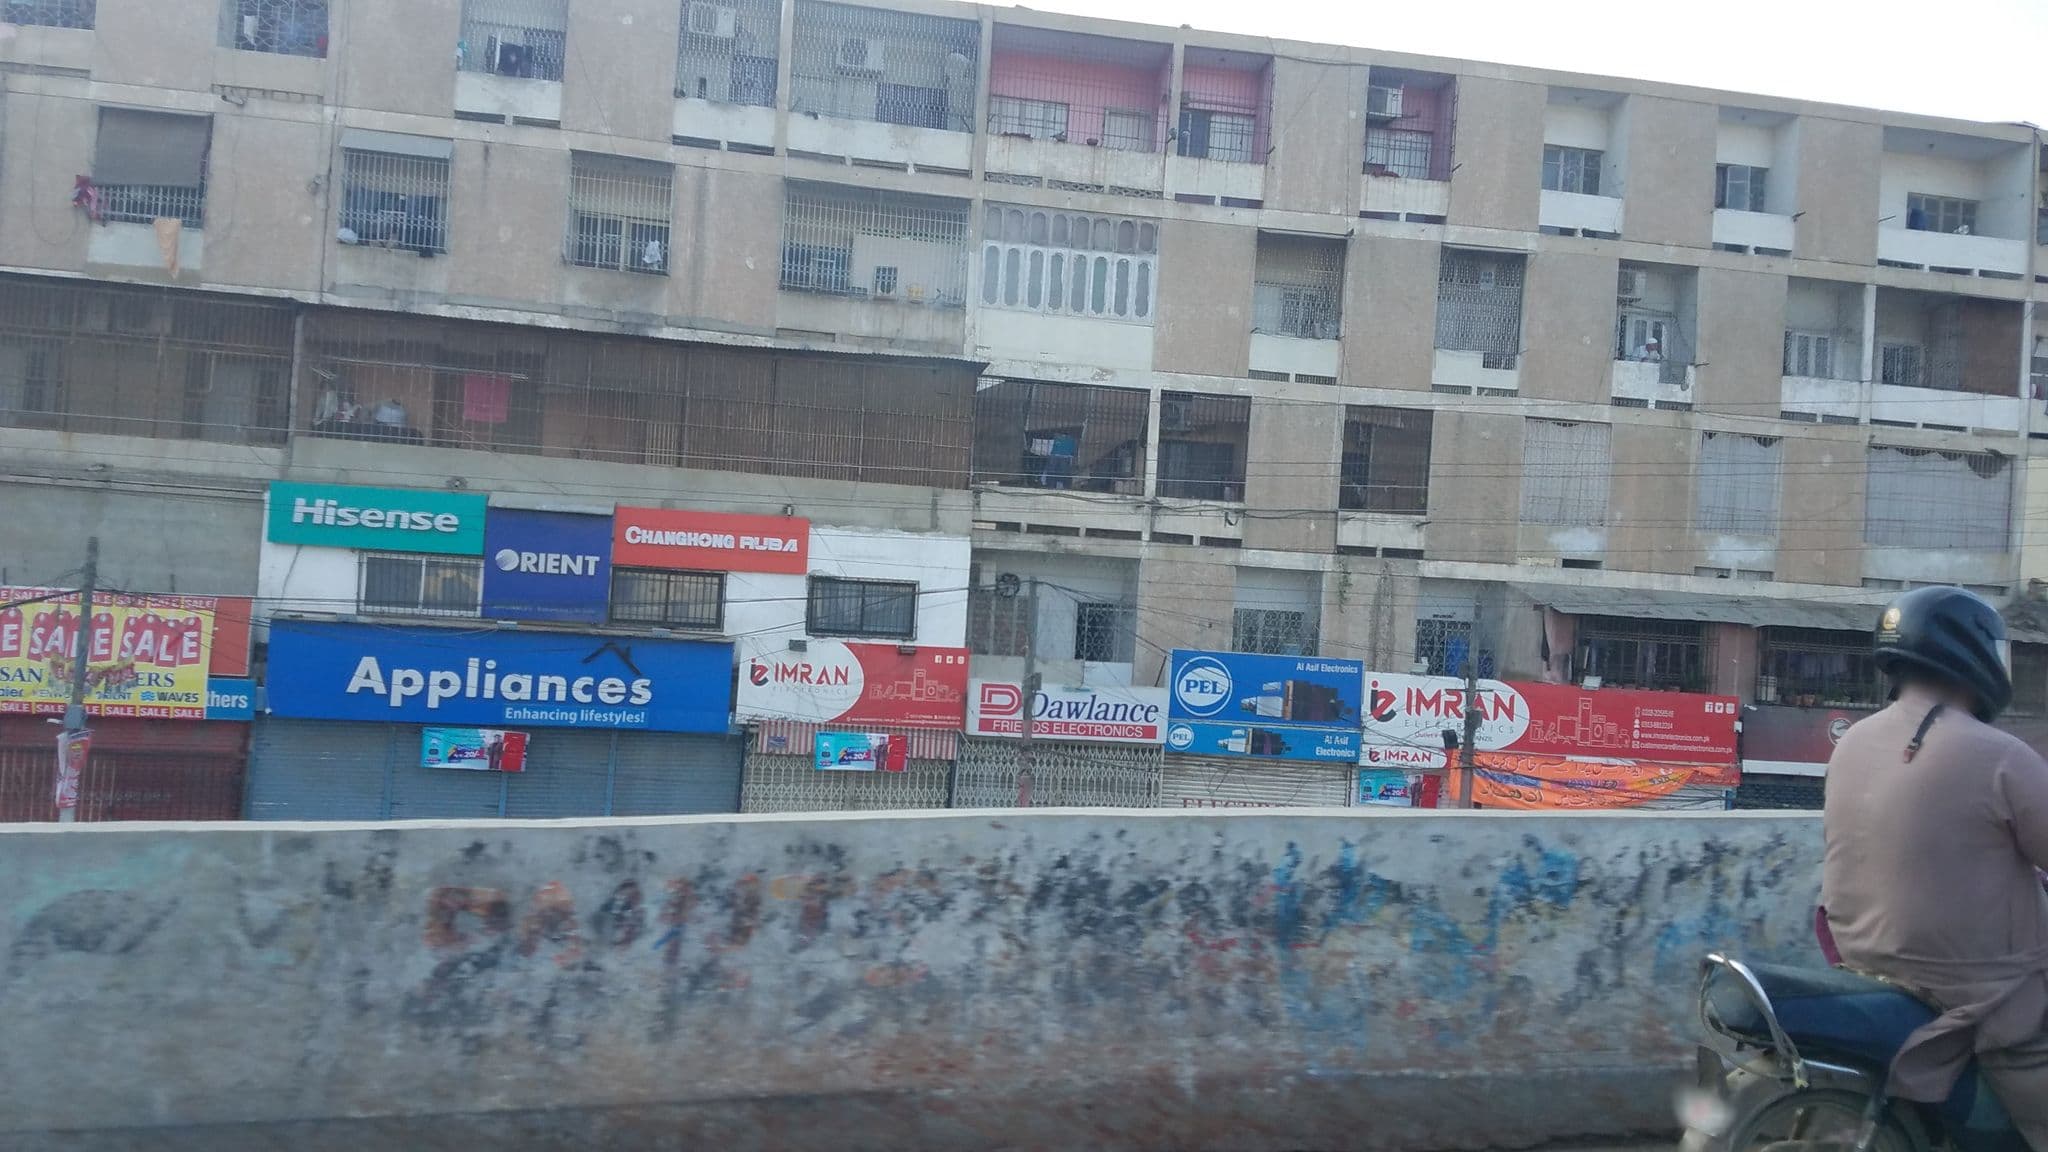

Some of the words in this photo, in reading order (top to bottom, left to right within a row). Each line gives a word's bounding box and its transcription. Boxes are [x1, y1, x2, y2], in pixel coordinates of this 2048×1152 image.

[292, 498, 459, 532] Hisense
[739, 536, 799, 553] RUBA
[495, 548, 600, 576] ORIENT
[119, 629, 199, 662] SALE
[774, 662, 849, 685] IMRAN
[1306, 663, 1320, 673] Asif
[1321, 664, 1358, 674] Electronics
[346, 656, 652, 708] Appliances
[1184, 679, 1224, 695] PEL
[157, 692, 198, 703] WAVES
[1406, 687, 1516, 722] IMRAN
[106, 706, 134, 715] SALE
[140, 708, 169, 717] SALE
[174, 709, 201, 718] SALE
[505, 707, 578, 723] Enhancing
[580, 709, 645, 725] lifestyles!
[1031, 692, 1159, 723] Dawlance
[993, 720, 1050, 733] FRIEDS
[1053, 723, 1143, 737] ELECTRONICS
[1172, 733, 1190, 742] PEL
[1315, 747, 1356, 757] Electronics
[1384, 750, 1432, 762] IMRAN
